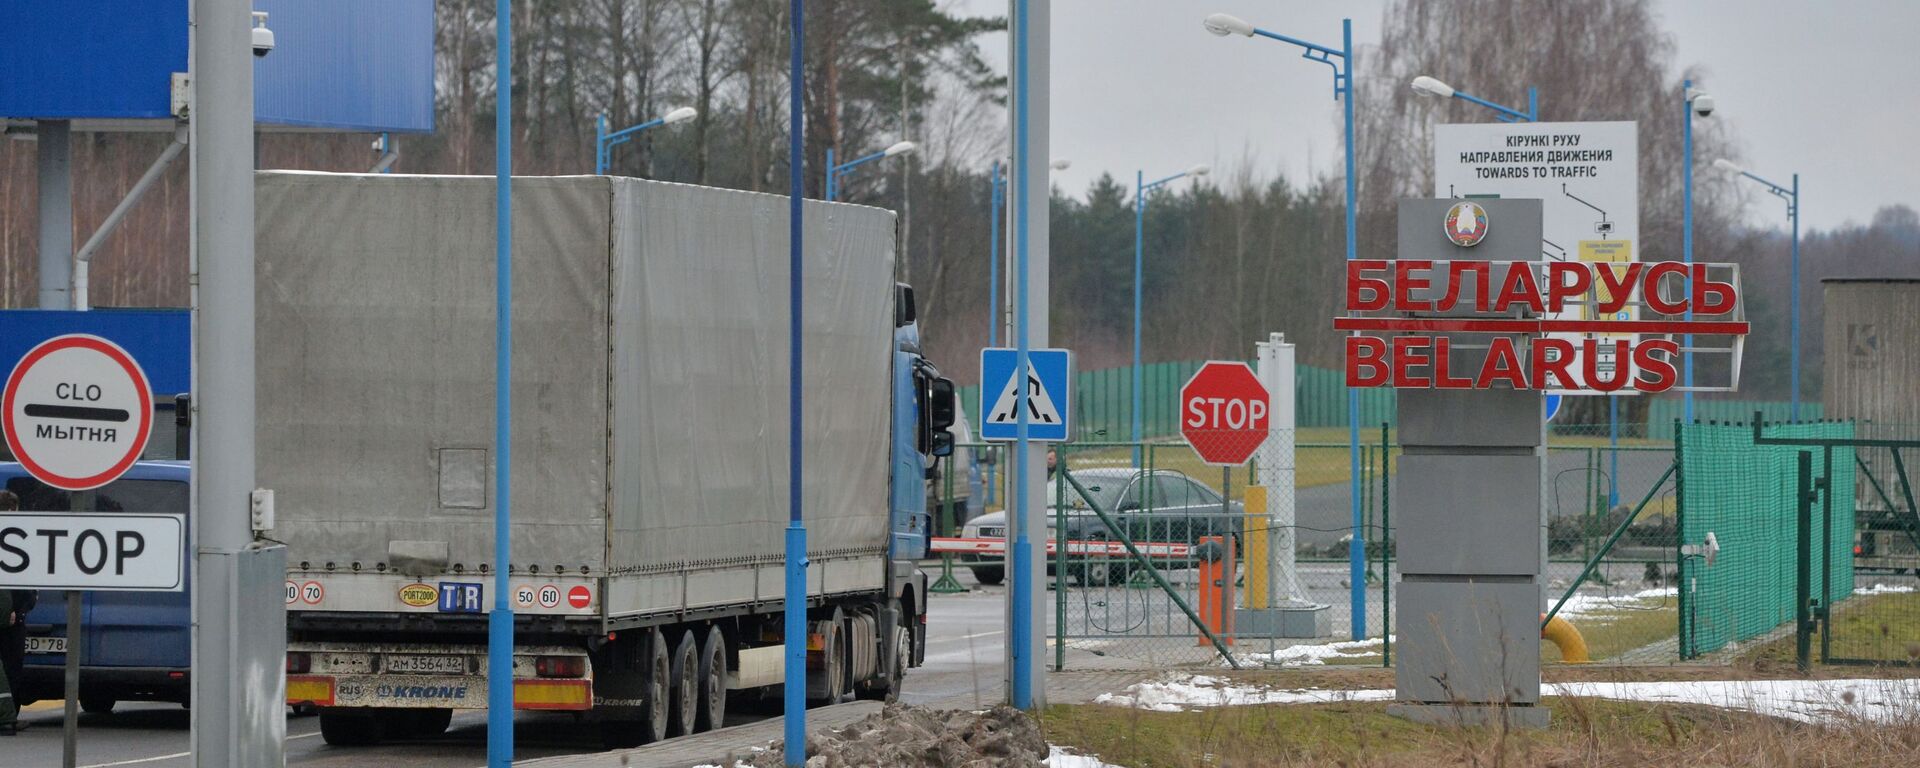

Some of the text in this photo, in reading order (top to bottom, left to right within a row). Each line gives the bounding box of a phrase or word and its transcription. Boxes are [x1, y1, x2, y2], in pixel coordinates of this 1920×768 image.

[1506, 134, 1580, 147] КІРУНКІ РУХУ
[1460, 150, 1612, 164] НАПРАВЛЕНИЯ ДВИЖЕНИЯ
[1476, 166, 1597, 179] TOWARDS TO TRAFFIC
[1345, 259, 1738, 315] БЕЛАРУСЬ
[1345, 336, 1680, 393] BELARUS
[56, 382, 102, 401] CLO
[1187, 396, 1267, 430] STOP
[36, 424, 117, 443] МЫТНЯ
[0, 526, 145, 575] STOP
[305, 587, 320, 599] 70
[518, 591, 533, 603] 50
[542, 590, 557, 603] 60
[48, 638, 67, 650] 78
[411, 658, 442, 670] 3564
[446, 658, 459, 668] 32
[340, 685, 360, 695] RUS
[392, 684, 468, 699] KRONE
